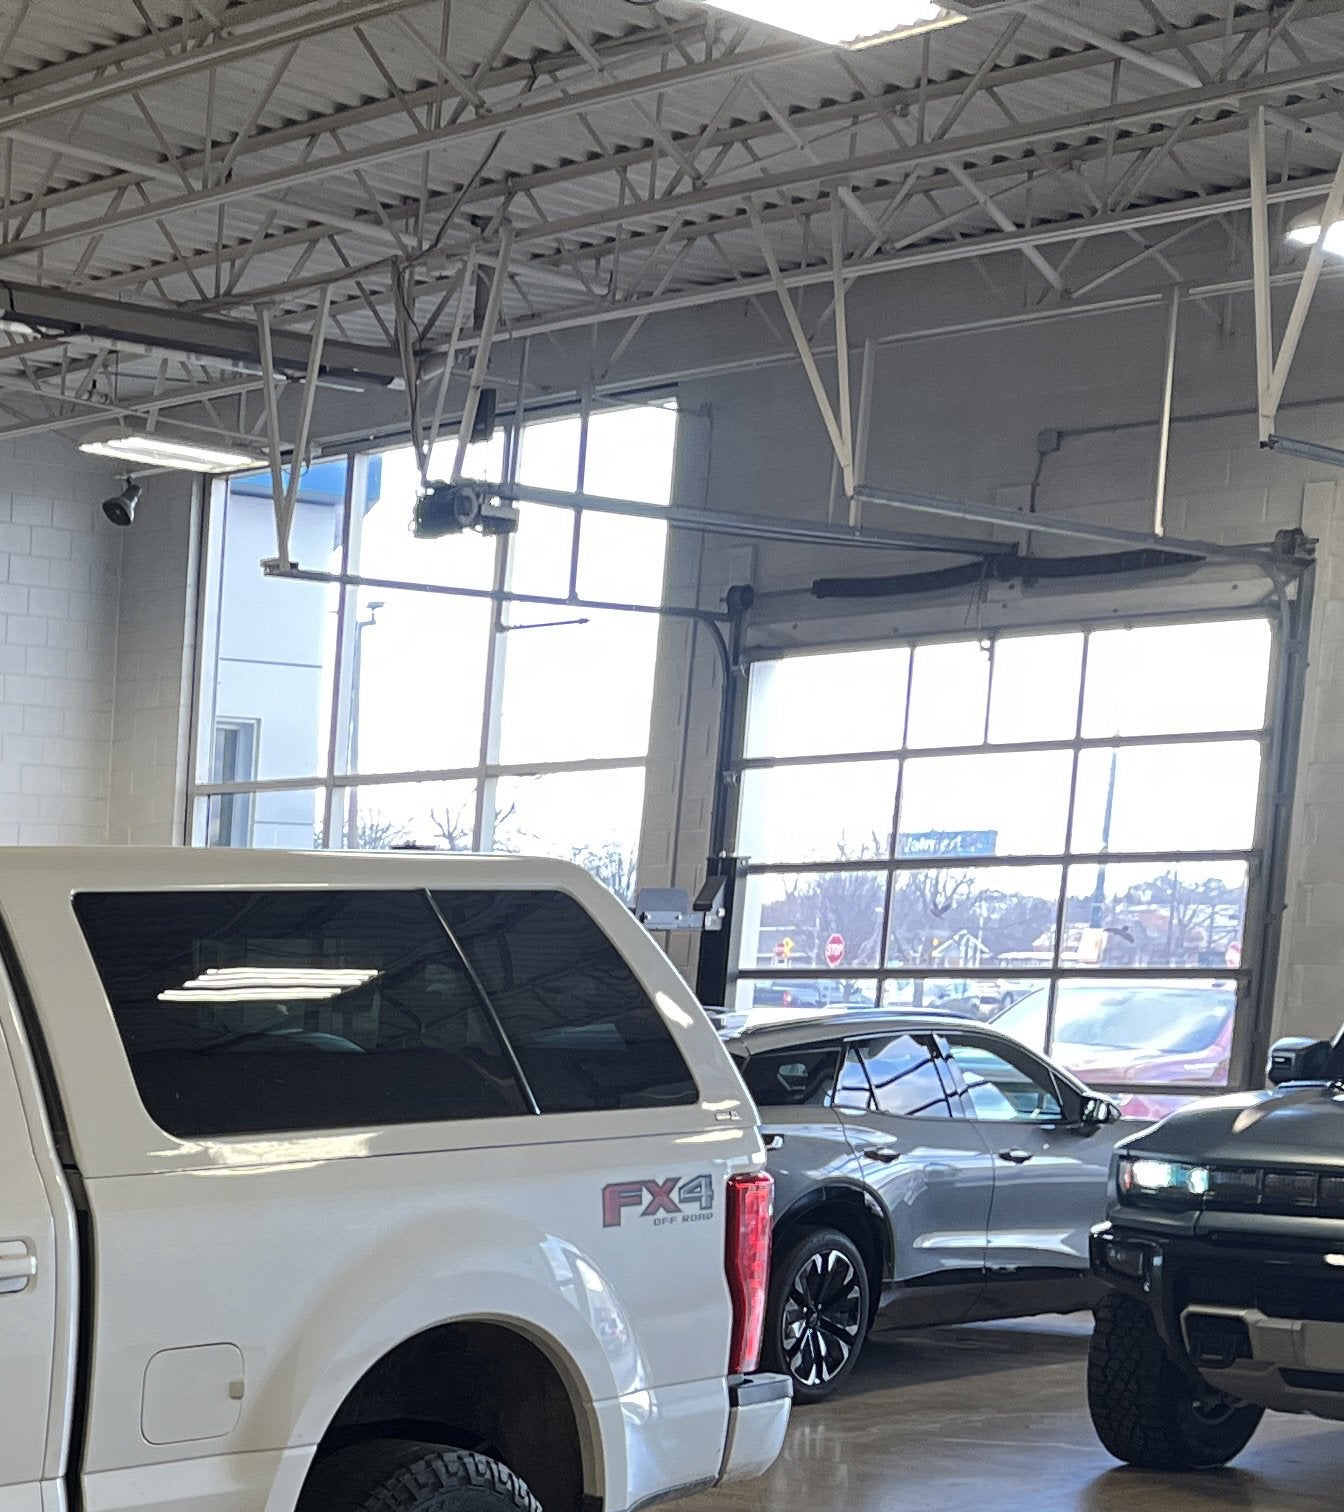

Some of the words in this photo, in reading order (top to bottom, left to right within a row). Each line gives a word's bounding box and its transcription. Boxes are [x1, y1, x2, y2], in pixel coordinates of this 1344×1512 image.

[826, 943, 844, 956] STOP
[602, 1174, 714, 1228] FX4
[653, 1216, 678, 1226] OFF
[682, 1212, 714, 1223] ROAD
